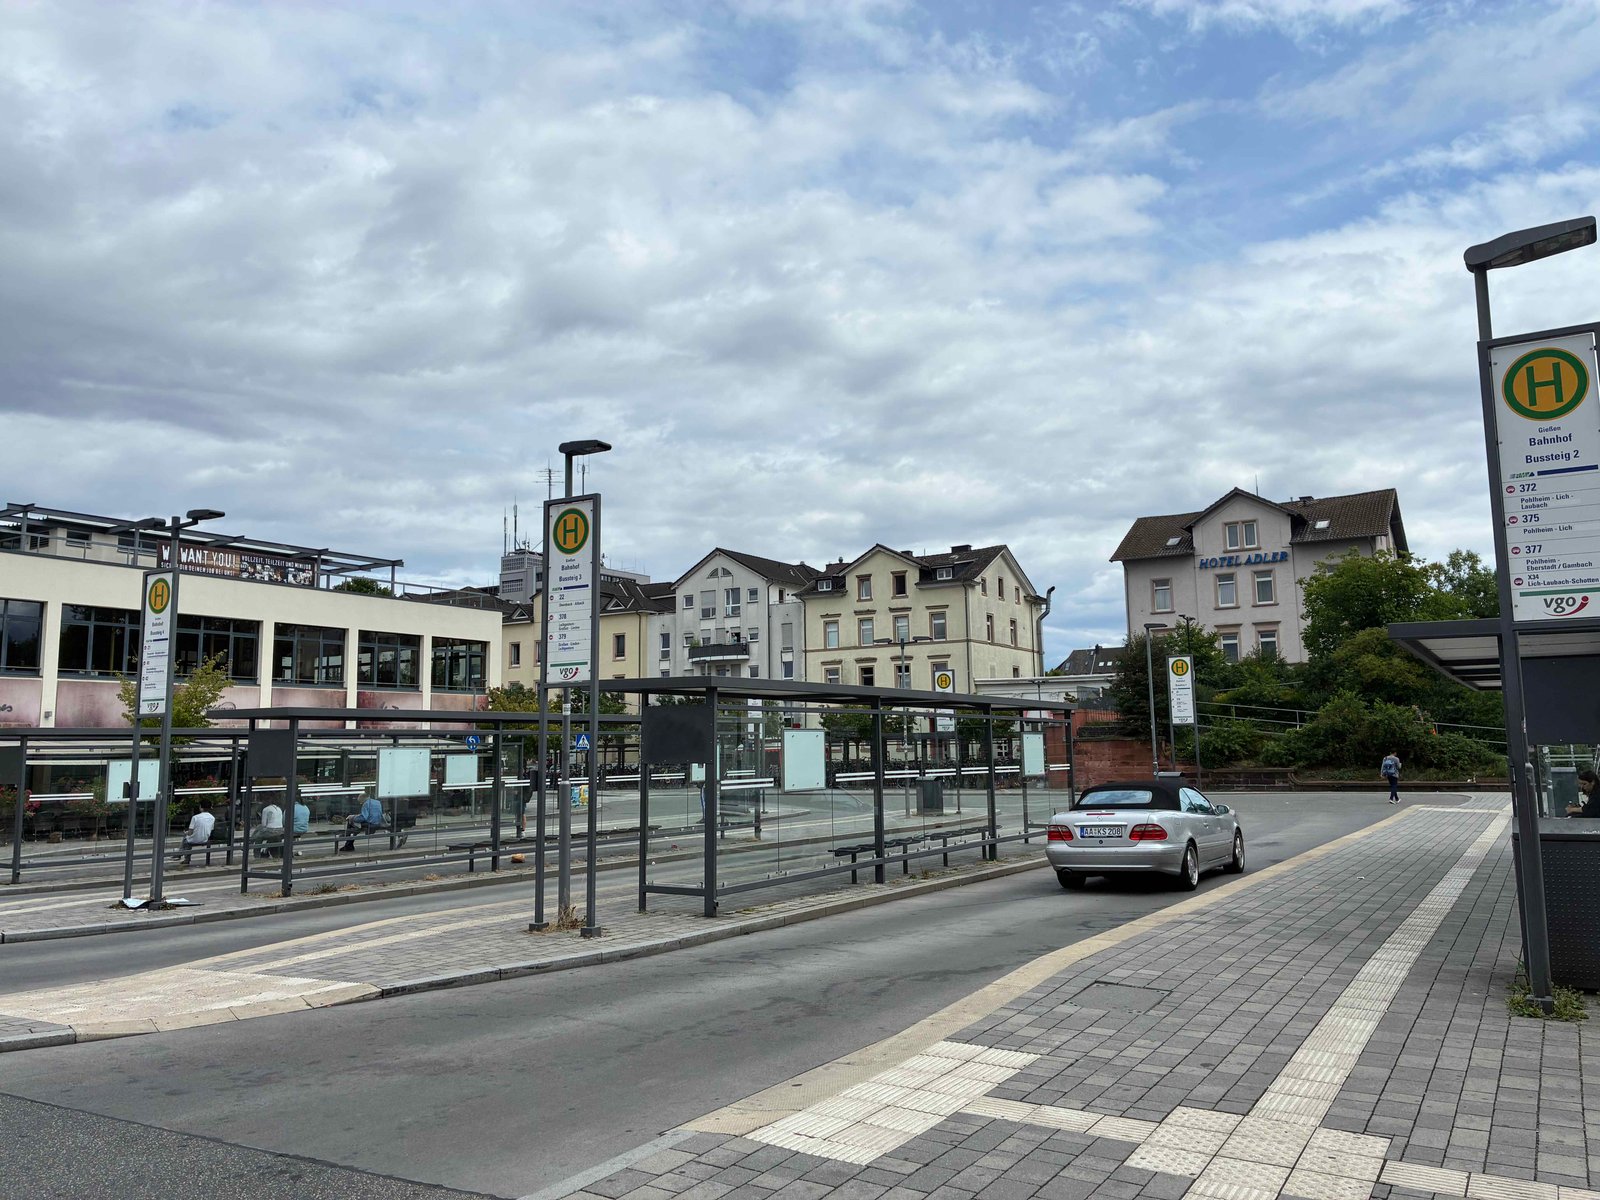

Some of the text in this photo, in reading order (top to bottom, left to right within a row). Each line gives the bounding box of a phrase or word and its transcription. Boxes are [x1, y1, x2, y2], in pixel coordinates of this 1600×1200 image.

[1525, 362, 1564, 407] H
[1529, 433, 1572, 446] Bahnhof
[1525, 450, 1580, 464] Bussteig 2
[1519, 483, 1537, 493] 372
[1520, 496, 1551, 504] Pohlheim
[1521, 502, 1548, 510] Laubach
[1522, 513, 1540, 523] 375
[563, 517, 578, 546] H
[1525, 545, 1542, 554] 377
[180, 548, 208, 565] WANT
[212, 552, 235, 568] YOU!
[1199, 551, 1288, 569] HOTEL ADLER
[1562, 561, 1593, 569] Gambach
[153, 585, 165, 607] H
[1543, 596, 1576, 613] vgo
